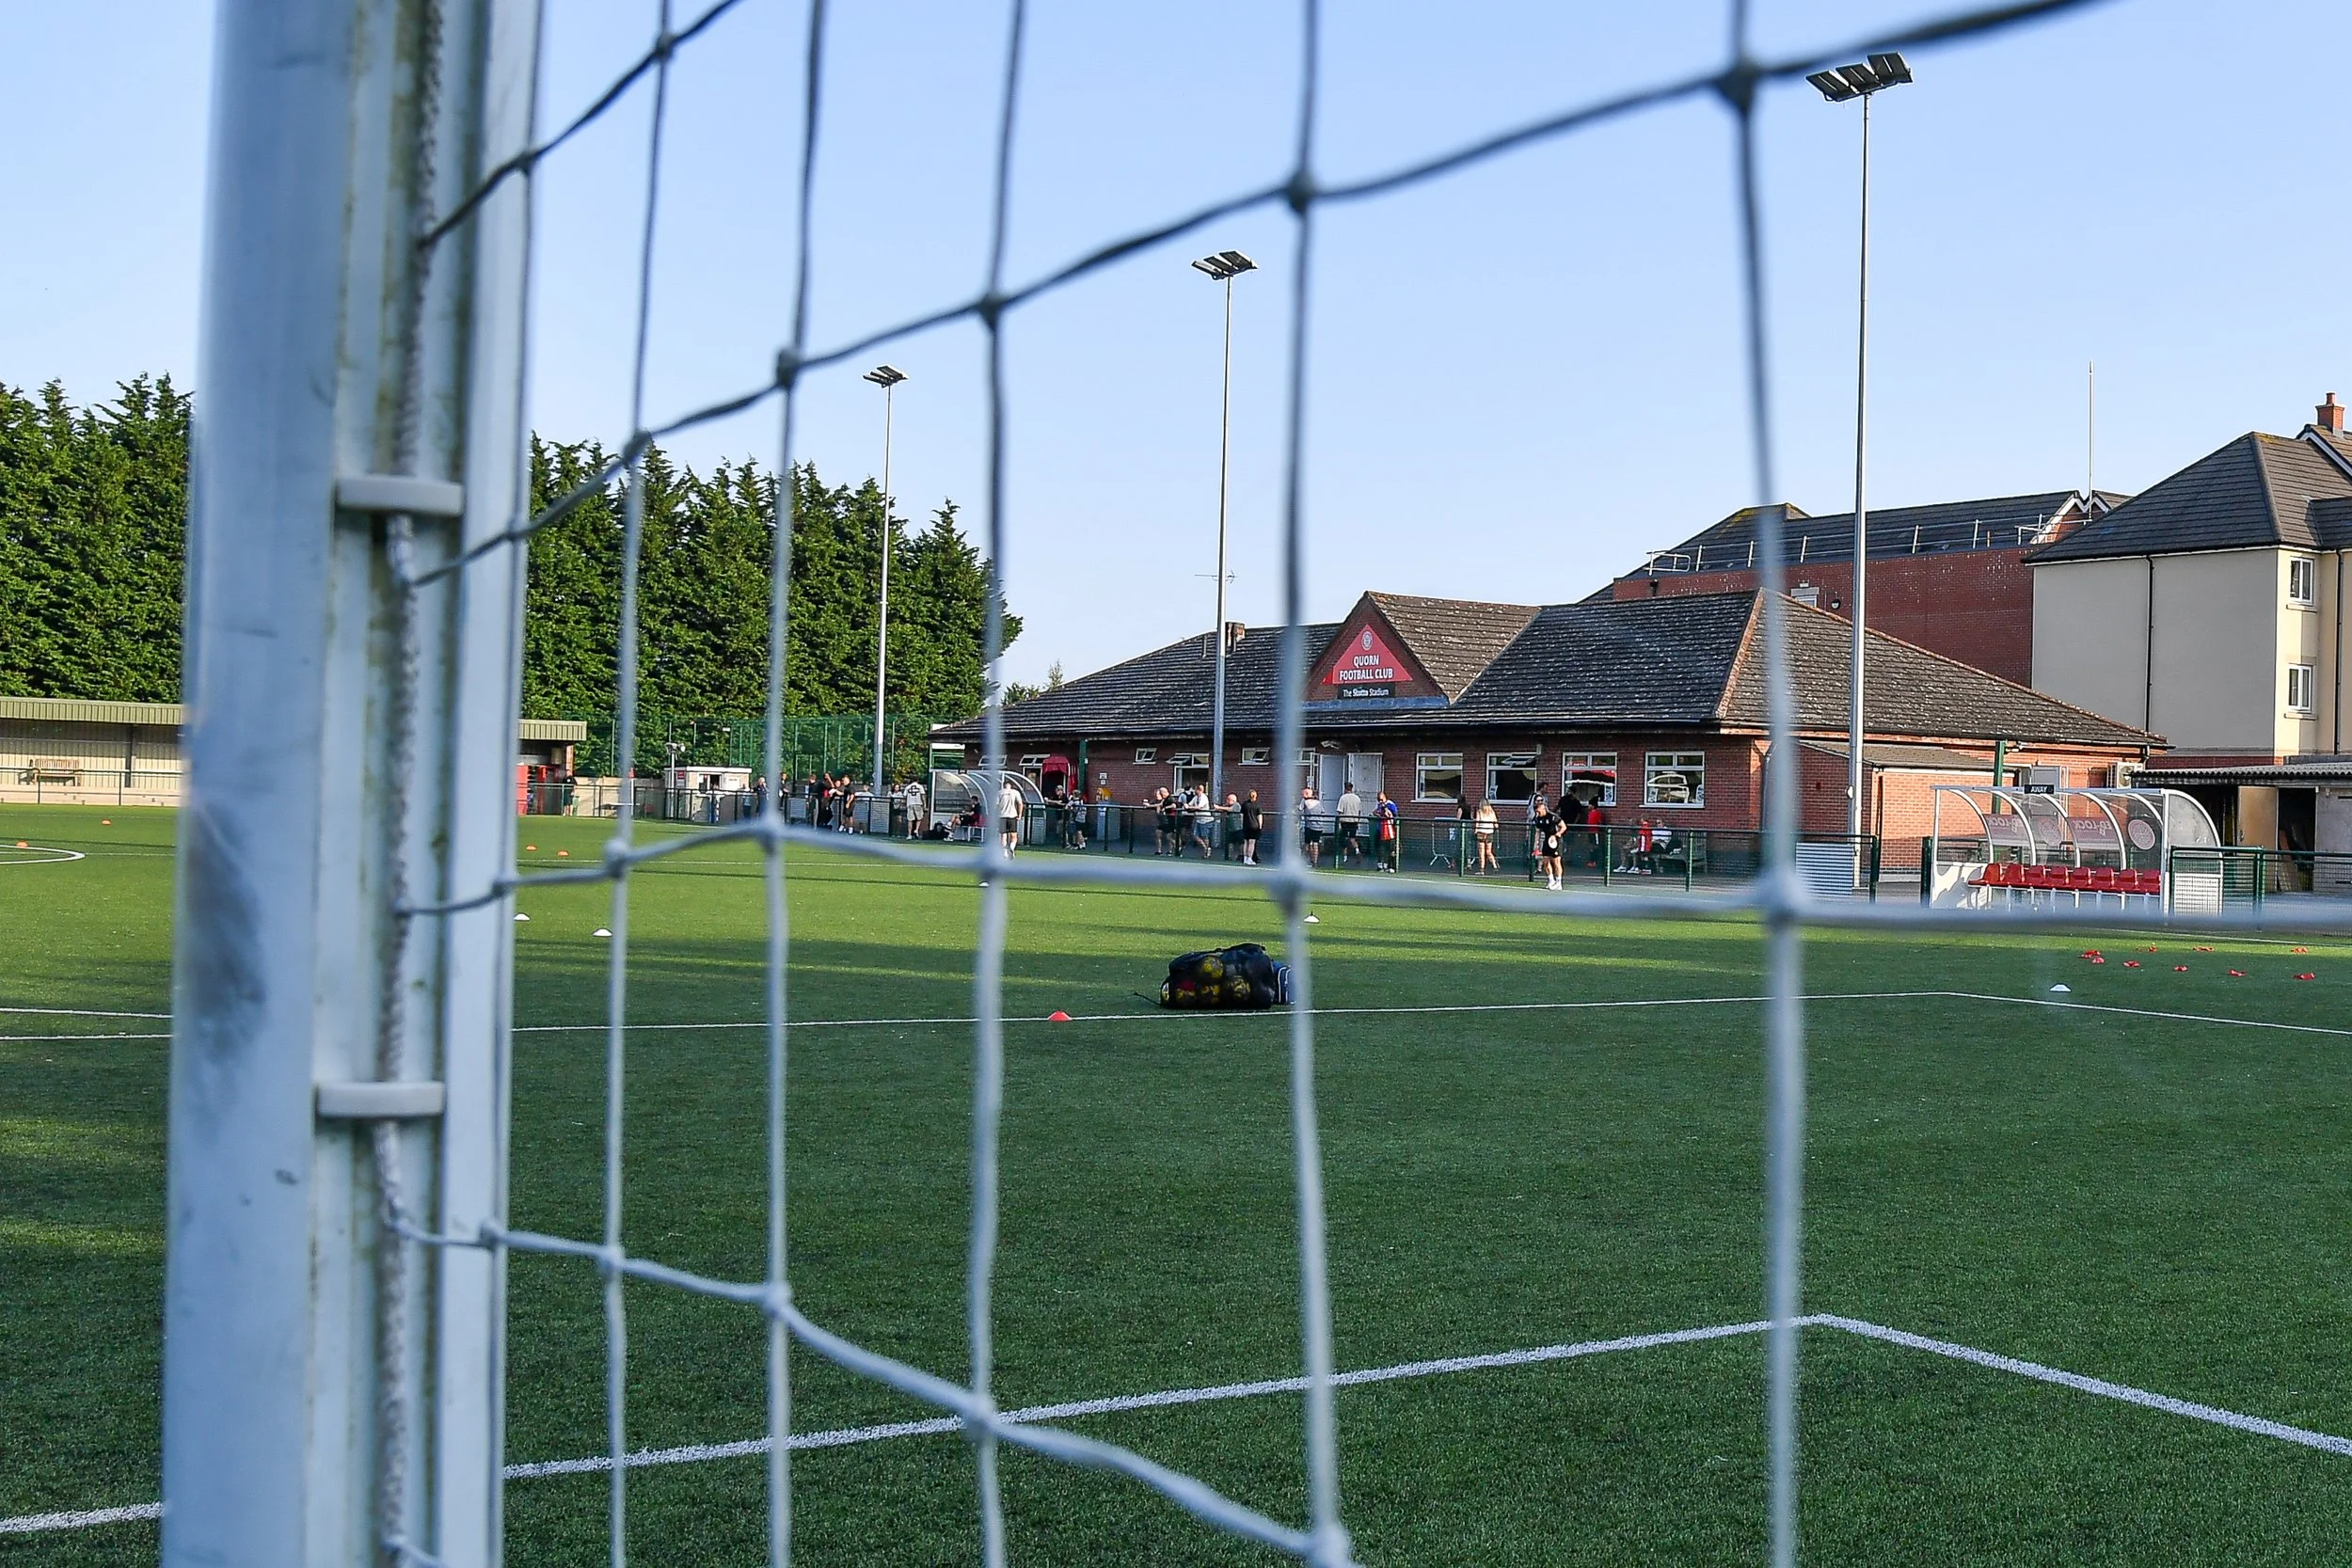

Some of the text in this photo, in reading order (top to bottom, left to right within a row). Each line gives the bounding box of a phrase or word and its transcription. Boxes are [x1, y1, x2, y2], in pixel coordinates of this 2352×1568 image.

[1354, 655, 1379, 668] QUORN
[1340, 668, 1393, 681] FOOTBALL CLUB
[1369, 688, 1389, 696] Stadium
